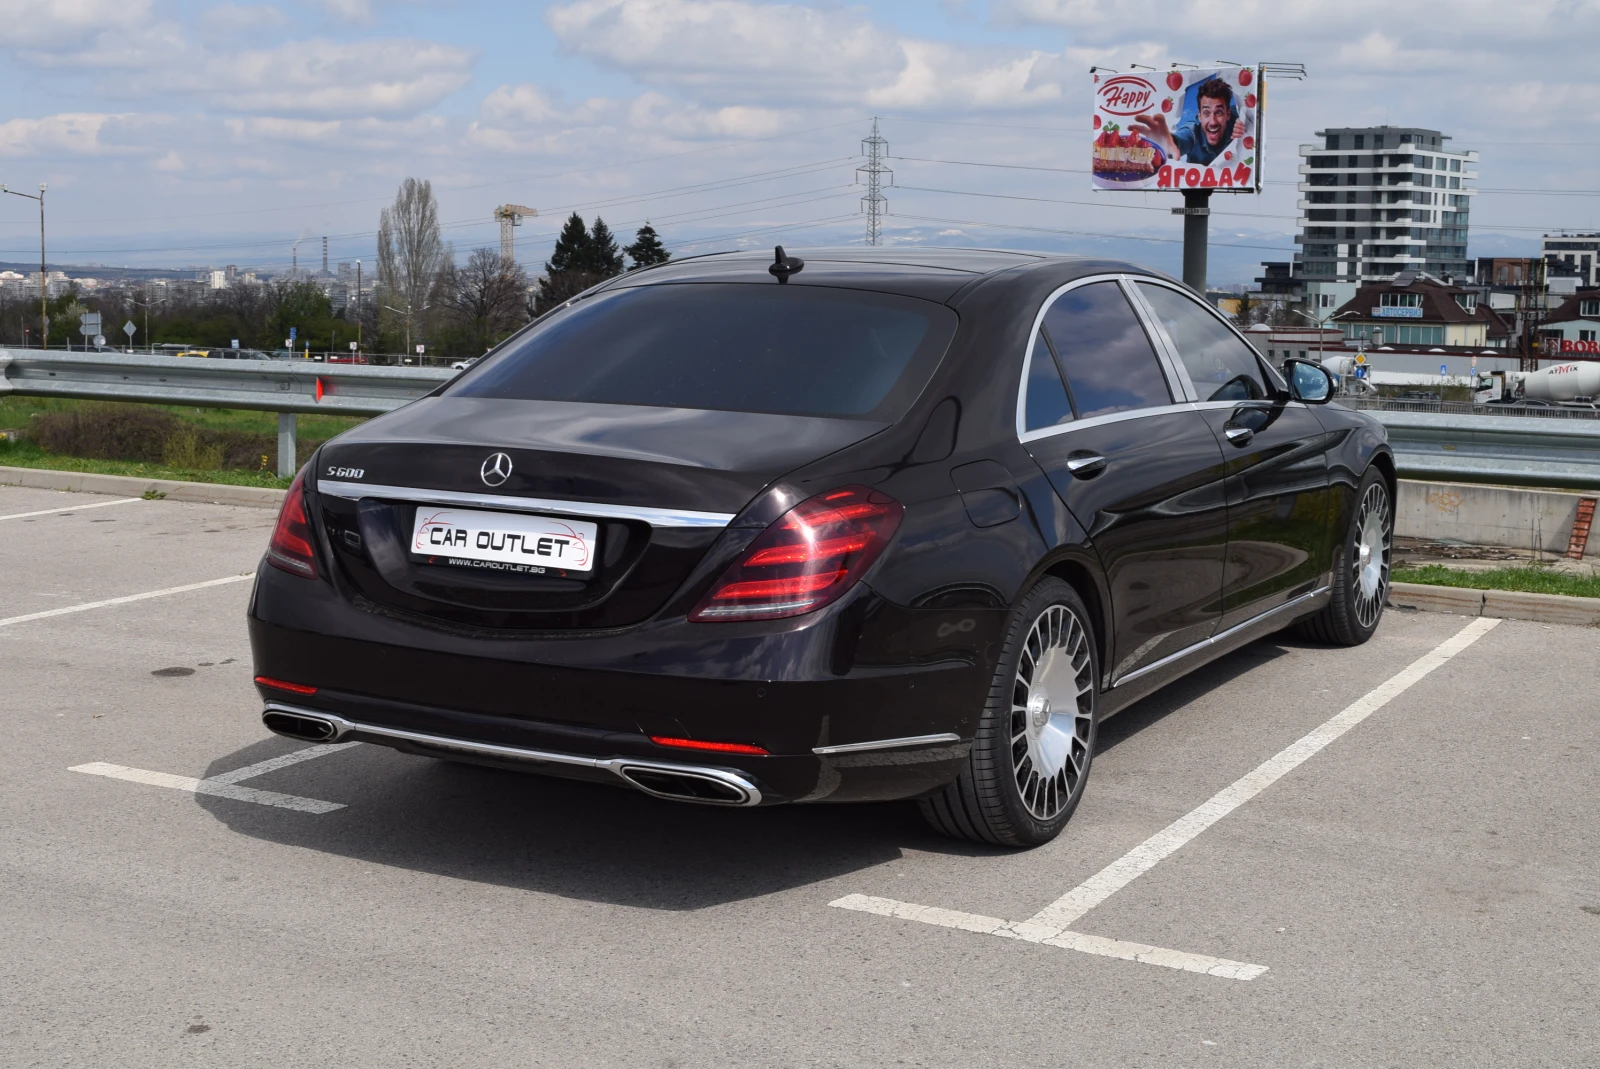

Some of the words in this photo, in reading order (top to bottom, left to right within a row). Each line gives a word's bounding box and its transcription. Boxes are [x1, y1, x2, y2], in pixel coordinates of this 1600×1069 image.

[1103, 86, 1151, 108] Happy
[1381, 307, 1421, 317] АВТОСЕРВИЗ
[430, 527, 467, 548] CAR
[476, 531, 571, 558] OUTLET
[448, 557, 546, 574] WWW.CAROUTLET.BG
